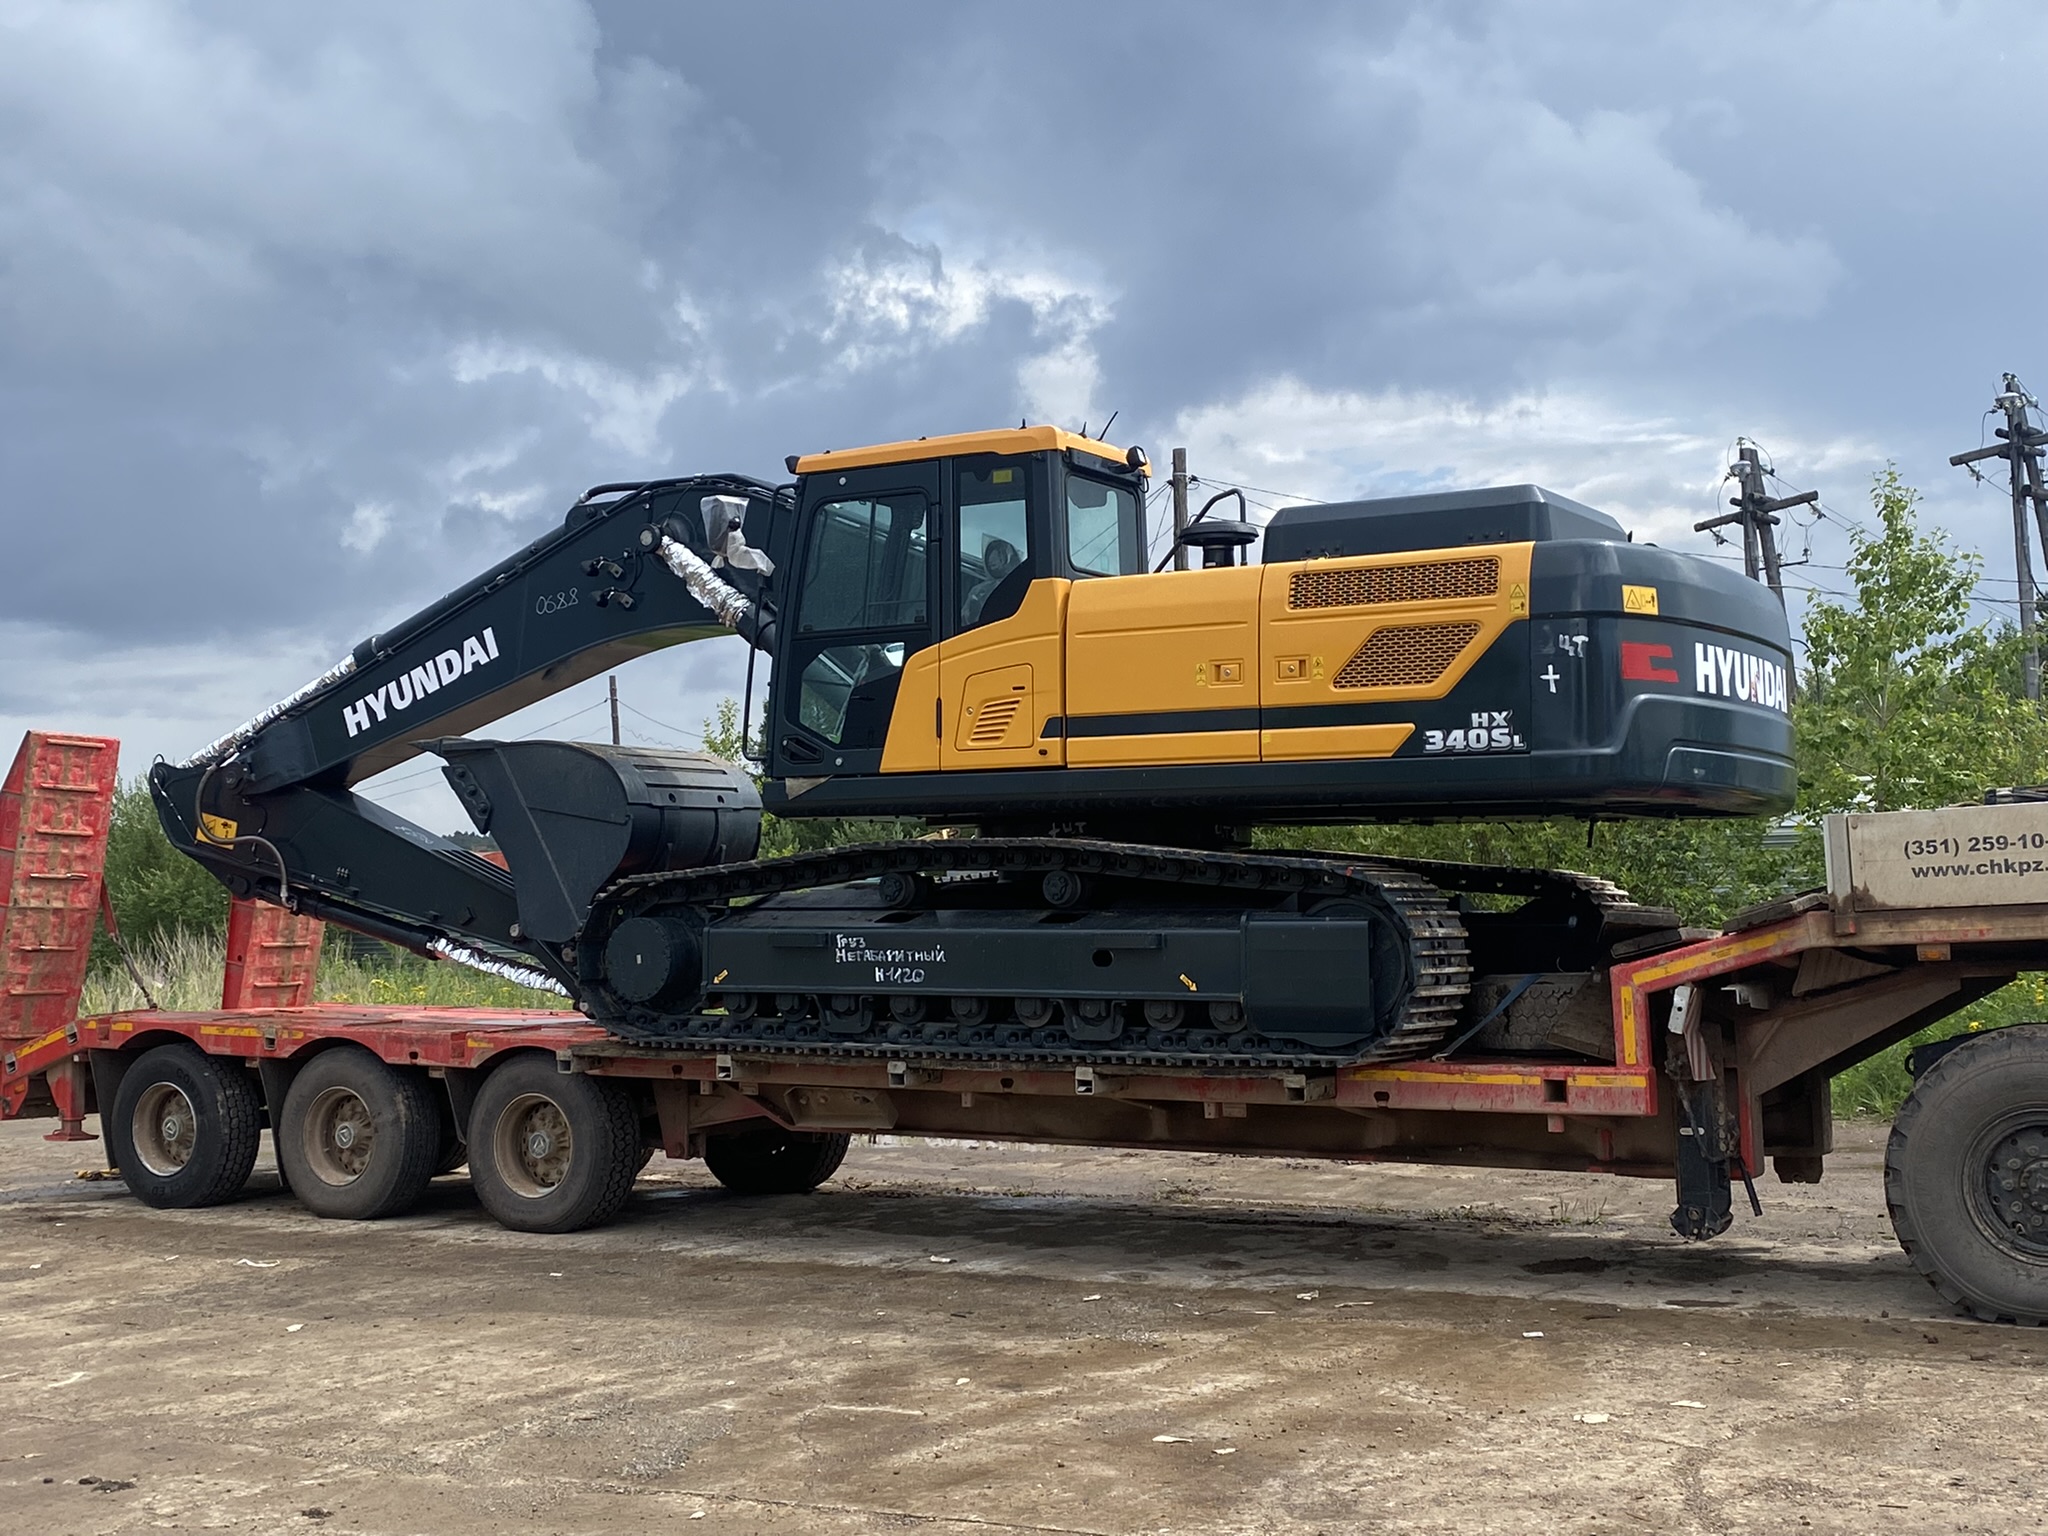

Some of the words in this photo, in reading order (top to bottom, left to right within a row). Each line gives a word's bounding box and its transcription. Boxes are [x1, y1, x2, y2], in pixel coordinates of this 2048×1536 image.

[536, 587, 579, 615] 0688
[342, 626, 500, 738] HYUNDAI
[1694, 641, 1788, 714] HYUNDAI
[1471, 710, 1511, 728] HX
[1903, 838, 1960, 859] (351)
